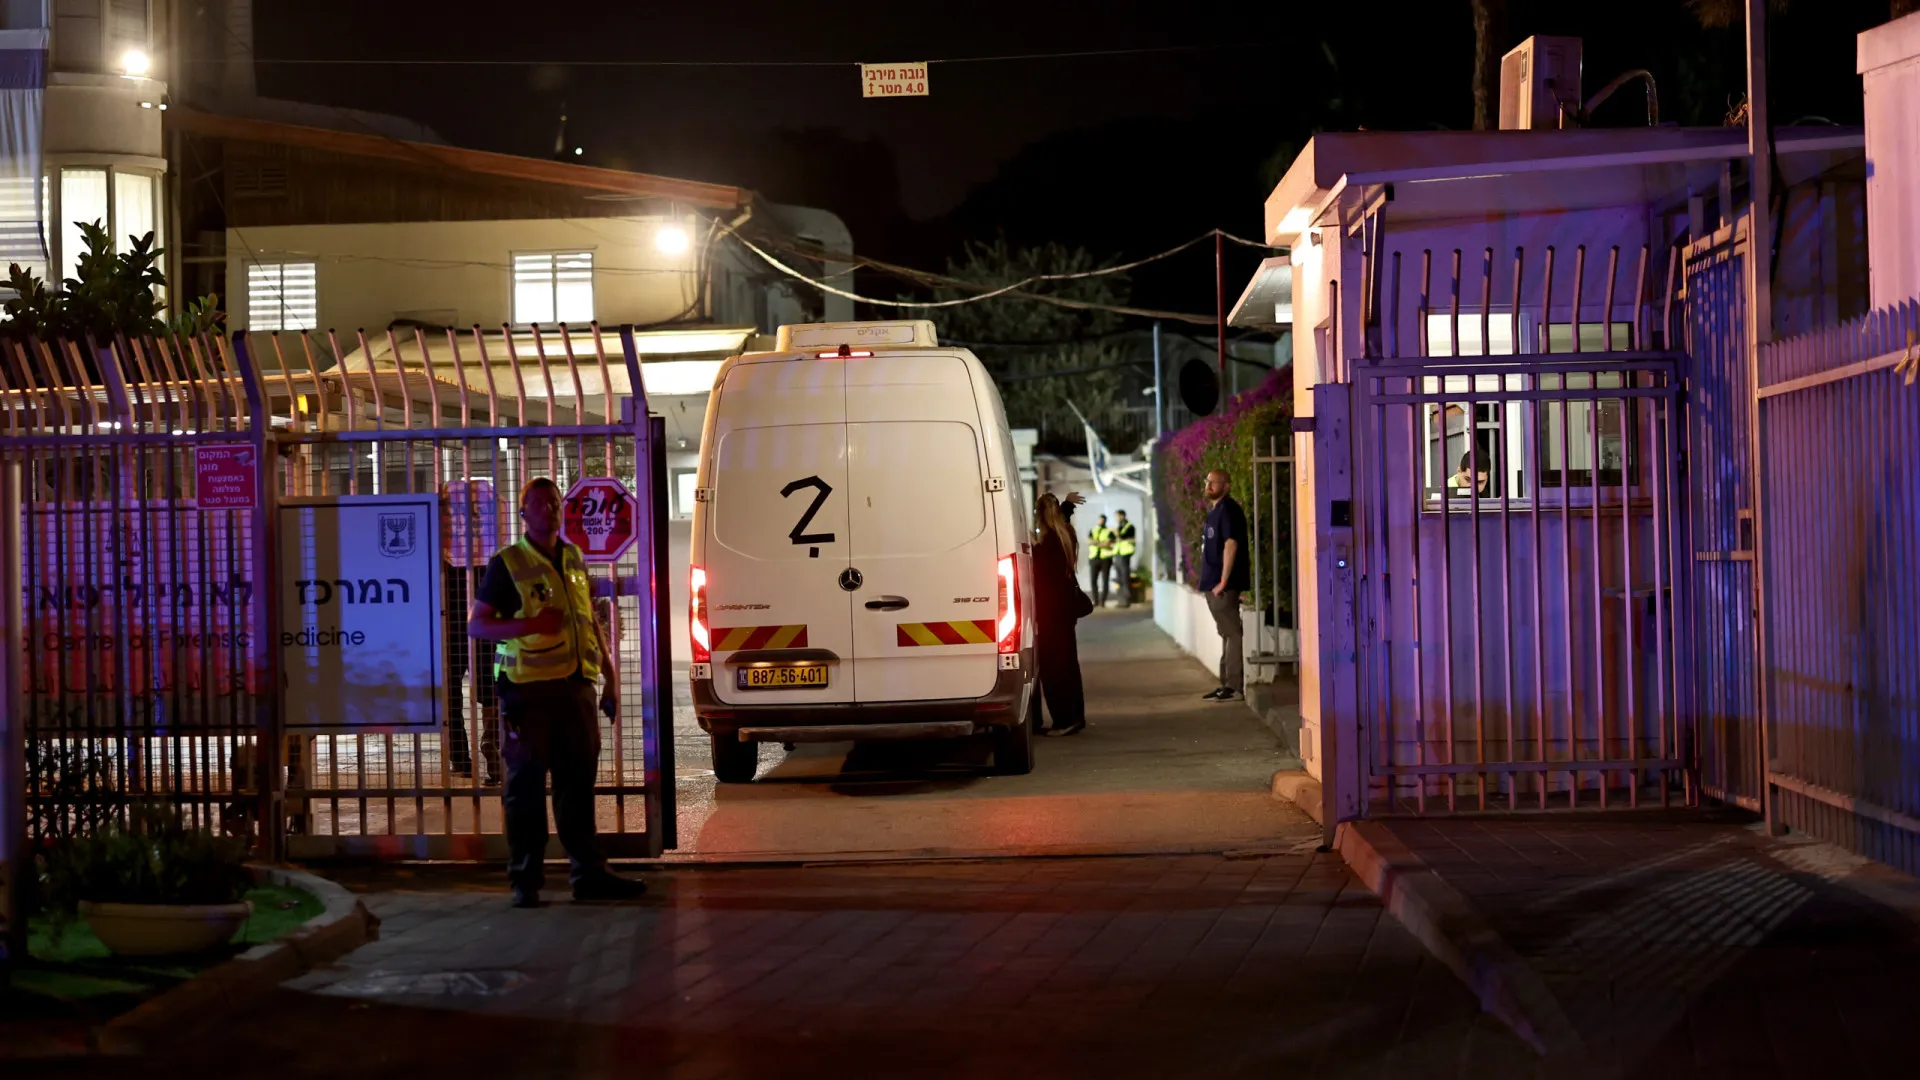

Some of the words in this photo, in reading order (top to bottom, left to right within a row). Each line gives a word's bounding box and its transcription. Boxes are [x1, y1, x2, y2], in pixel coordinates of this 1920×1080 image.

[865, 69, 896, 81] מירבי
[900, 68, 925, 80] גובה
[878, 84, 902, 94] מטר
[905, 82, 924, 94] 4.0
[199, 450, 231, 461] המקום
[199, 463, 218, 474] מוגן
[295, 578, 410, 605] המרכז
[281, 626, 365, 646] edicine
